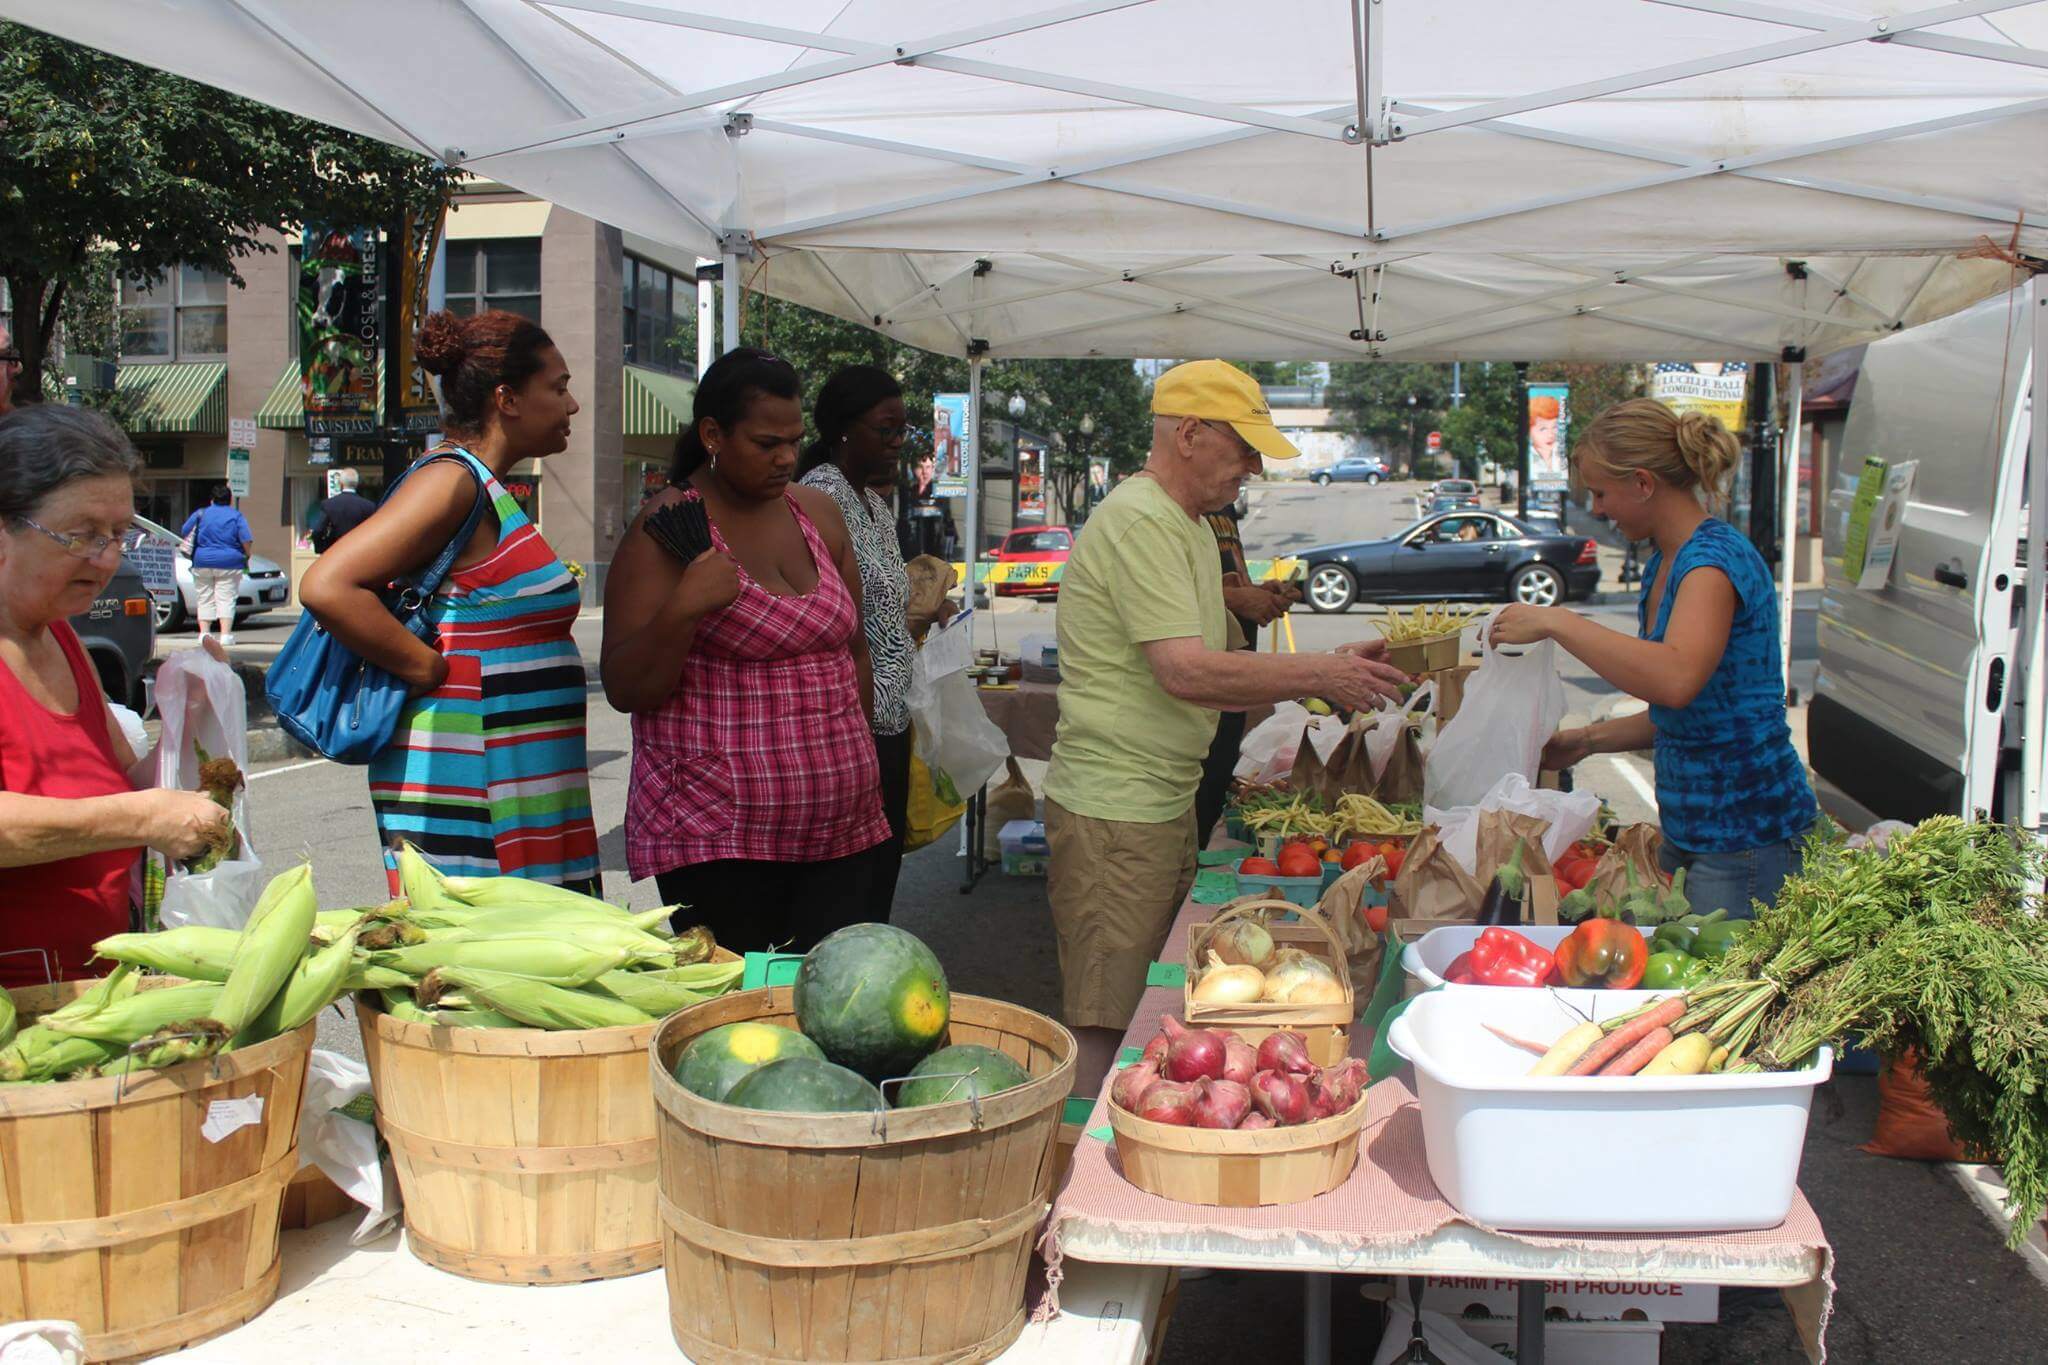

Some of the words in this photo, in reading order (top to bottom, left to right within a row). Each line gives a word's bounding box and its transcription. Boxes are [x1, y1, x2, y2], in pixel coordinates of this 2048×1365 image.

[362, 230, 376, 284] FRESH
[362, 291, 375, 300] &
[361, 305, 376, 361] CLOSE
[361, 366, 374, 388] UP
[1664, 375, 1709, 387] LUCILLE
[1714, 380, 1741, 389] BALL
[1663, 385, 1699, 395] COMEDY
[1703, 388, 1741, 398] FESTIVAL
[1007, 566, 1049, 579] PARKS
[1426, 1276, 1488, 1291] FARM
[1494, 1278, 1568, 1294] FRSH
[1574, 1279, 1684, 1297] PRODUCE
